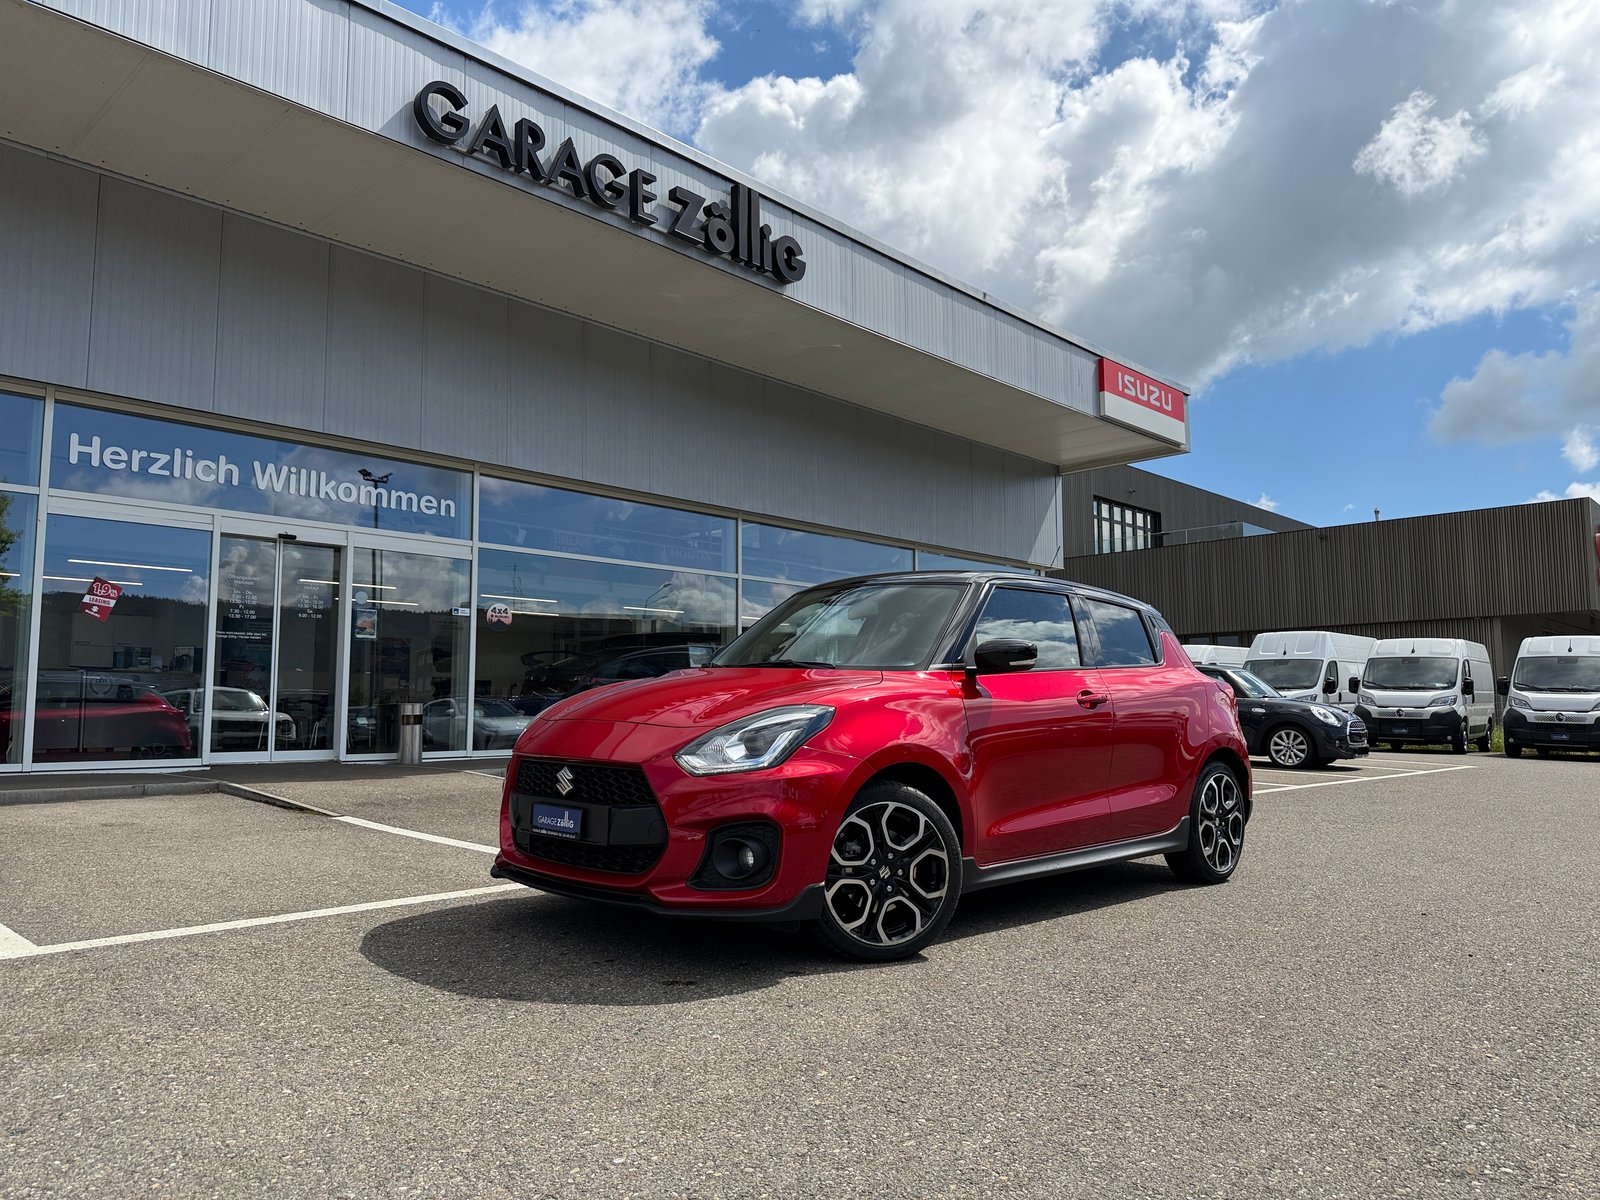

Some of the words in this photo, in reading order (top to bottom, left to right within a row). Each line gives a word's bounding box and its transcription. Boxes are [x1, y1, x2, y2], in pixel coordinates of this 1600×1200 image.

[414, 81, 658, 225] GARAGE
[1118, 371, 1172, 412] ISUZU
[69, 432, 240, 486] Herzlich
[253, 460, 456, 518] Willkommen
[89, 597, 110, 605] LEASING
[491, 607, 509, 615] 4x4
[538, 816, 557, 825] GARAGE
